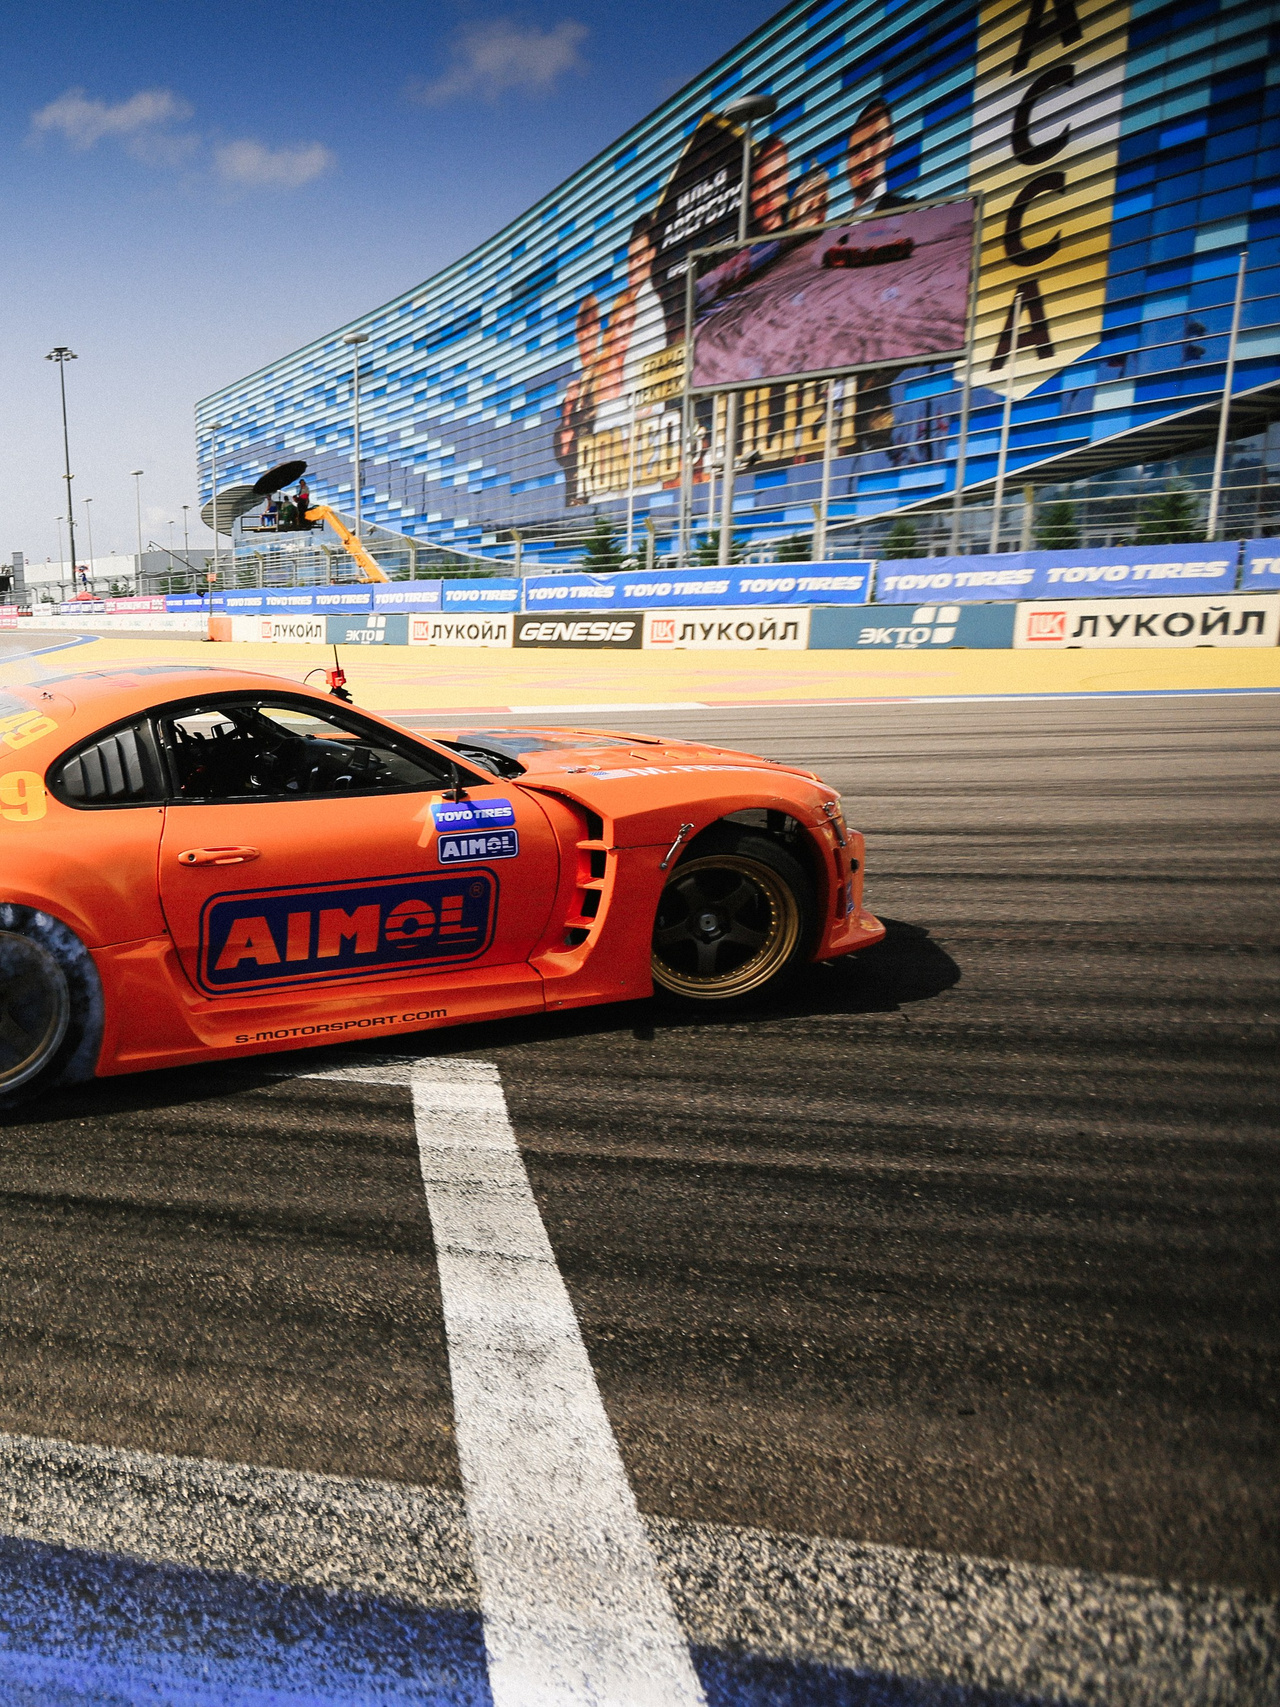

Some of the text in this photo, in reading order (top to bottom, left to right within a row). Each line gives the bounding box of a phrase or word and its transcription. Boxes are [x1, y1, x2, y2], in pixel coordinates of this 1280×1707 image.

[884, 568, 1036, 591] TOYO TIRES
[1046, 560, 1230, 583] TOYO TIRES
[528, 585, 616, 600] TOYO TIRES
[623, 580, 730, 598] TOYO TIRES
[739, 576, 865, 593] TOYO TIRES
[266, 595, 313, 606] TOYO TIRES
[315, 593, 370, 605] TOYO TIRES
[375, 591, 439, 604] TOYO TIRES
[445, 589, 518, 601] TOYO TIRES
[273, 622, 322, 638] ЛУКОЙЛ
[431, 620, 507, 640] ЛУКОЙЛ
[679, 617, 798, 641] ЛУКОЙЛ
[1072, 606, 1267, 638] ЛУКОЙЛ
[345, 629, 375, 642] ЭКТО
[519, 621, 636, 642] GENESIS
[857, 627, 932, 645] ЭКТО
[436, 806, 512, 822] TOYO TIRES
[442, 835, 515, 858] AIMOL
[214, 894, 479, 971] AIMOL
